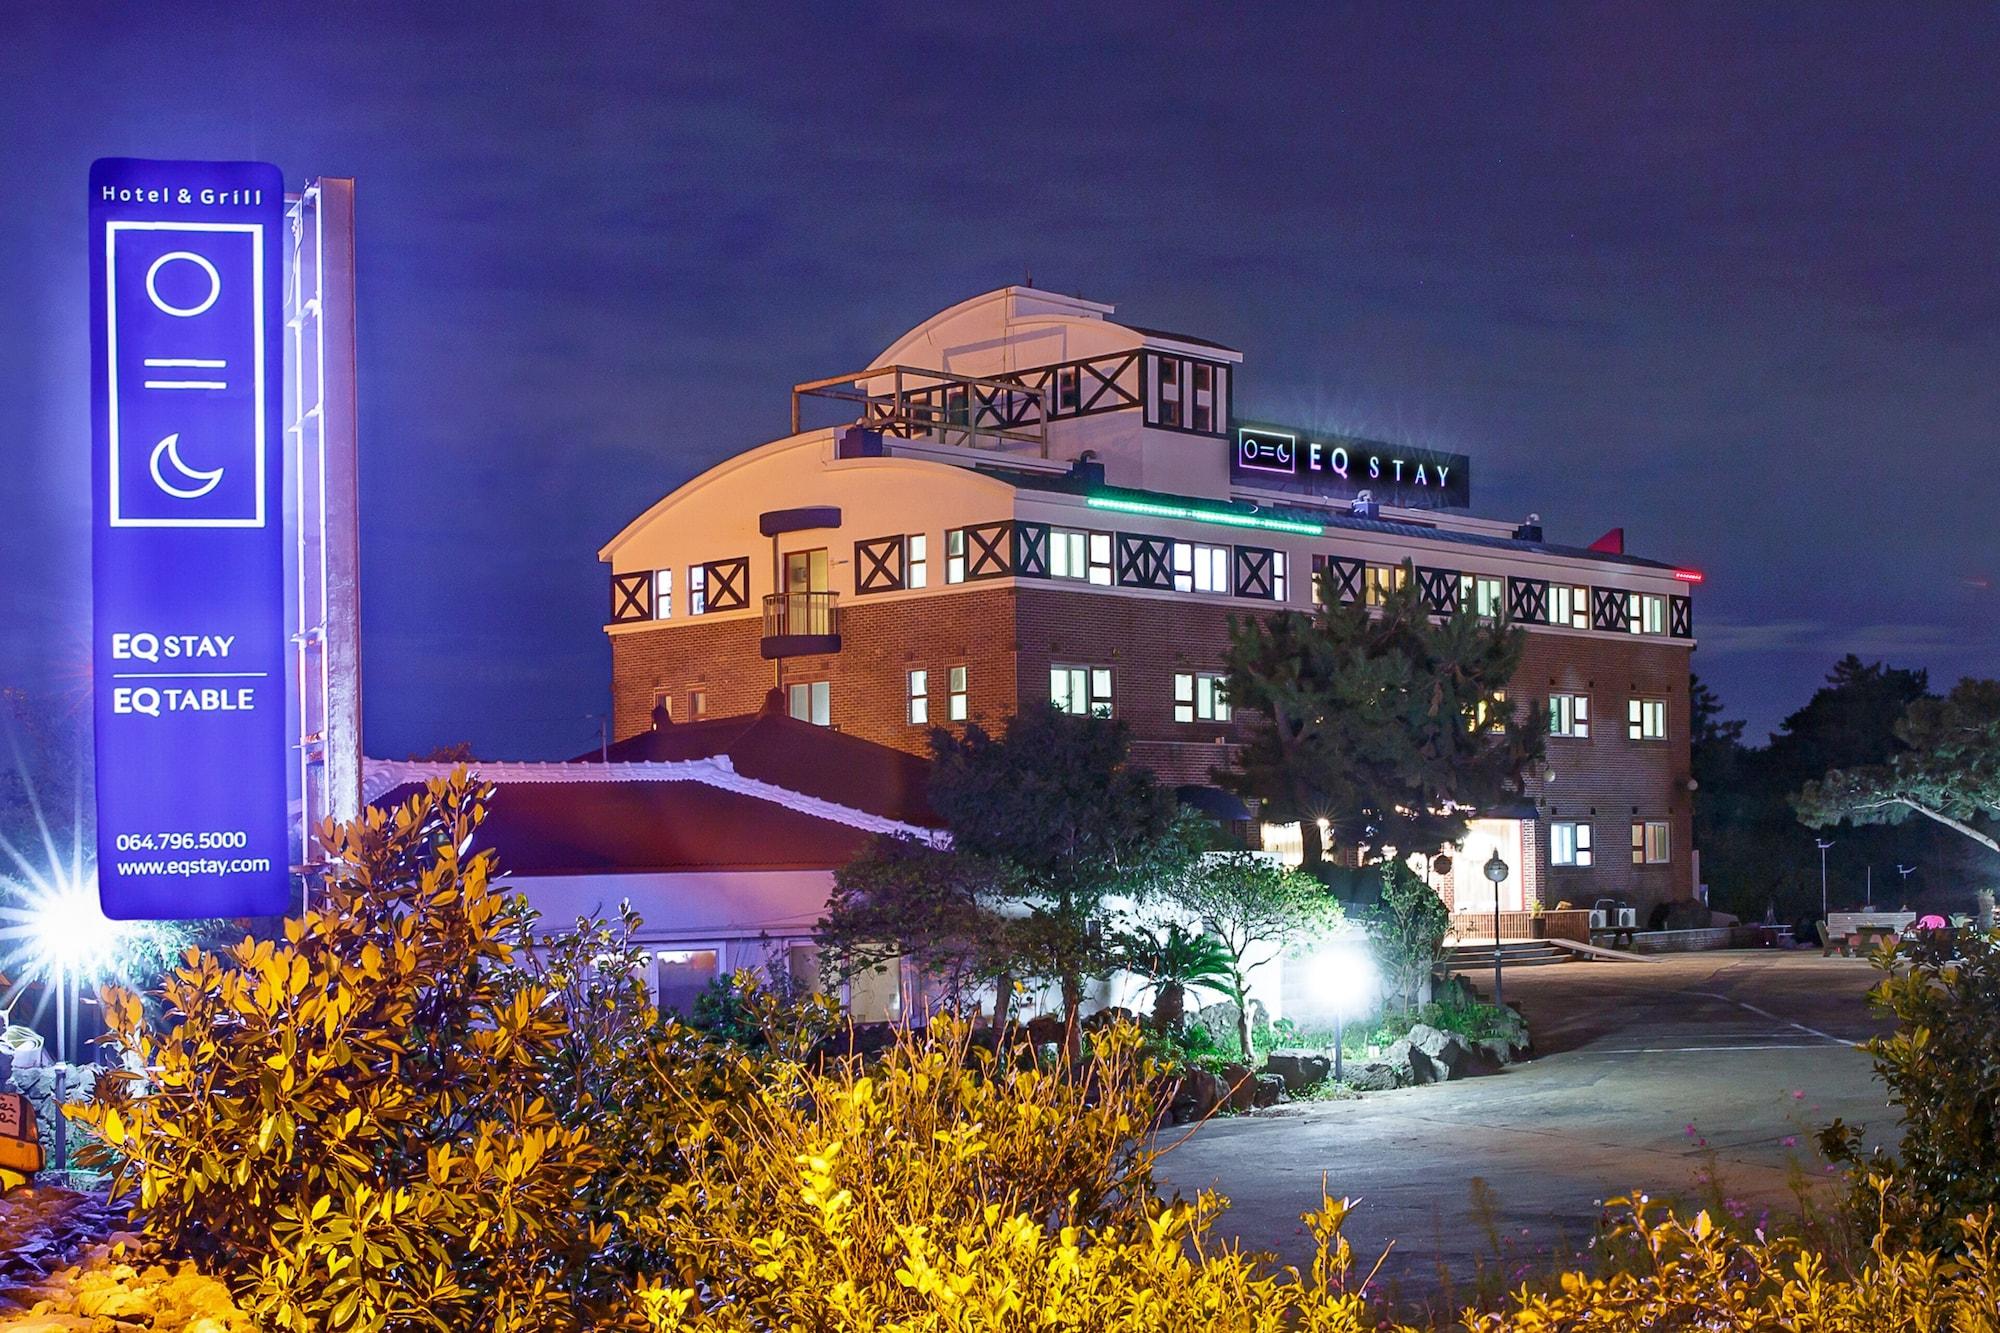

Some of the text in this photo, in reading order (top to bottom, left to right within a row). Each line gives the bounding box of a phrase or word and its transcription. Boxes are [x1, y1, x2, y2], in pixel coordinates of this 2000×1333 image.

[102, 185, 262, 206] Hotel & Grill
[1310, 443, 1449, 488] EQ STAY
[112, 632, 235, 663] EQ STAY
[113, 687, 255, 717] EQ TABLE
[116, 831, 247, 851] 064.796.5000
[117, 857, 271, 878] www.eqstay.com
